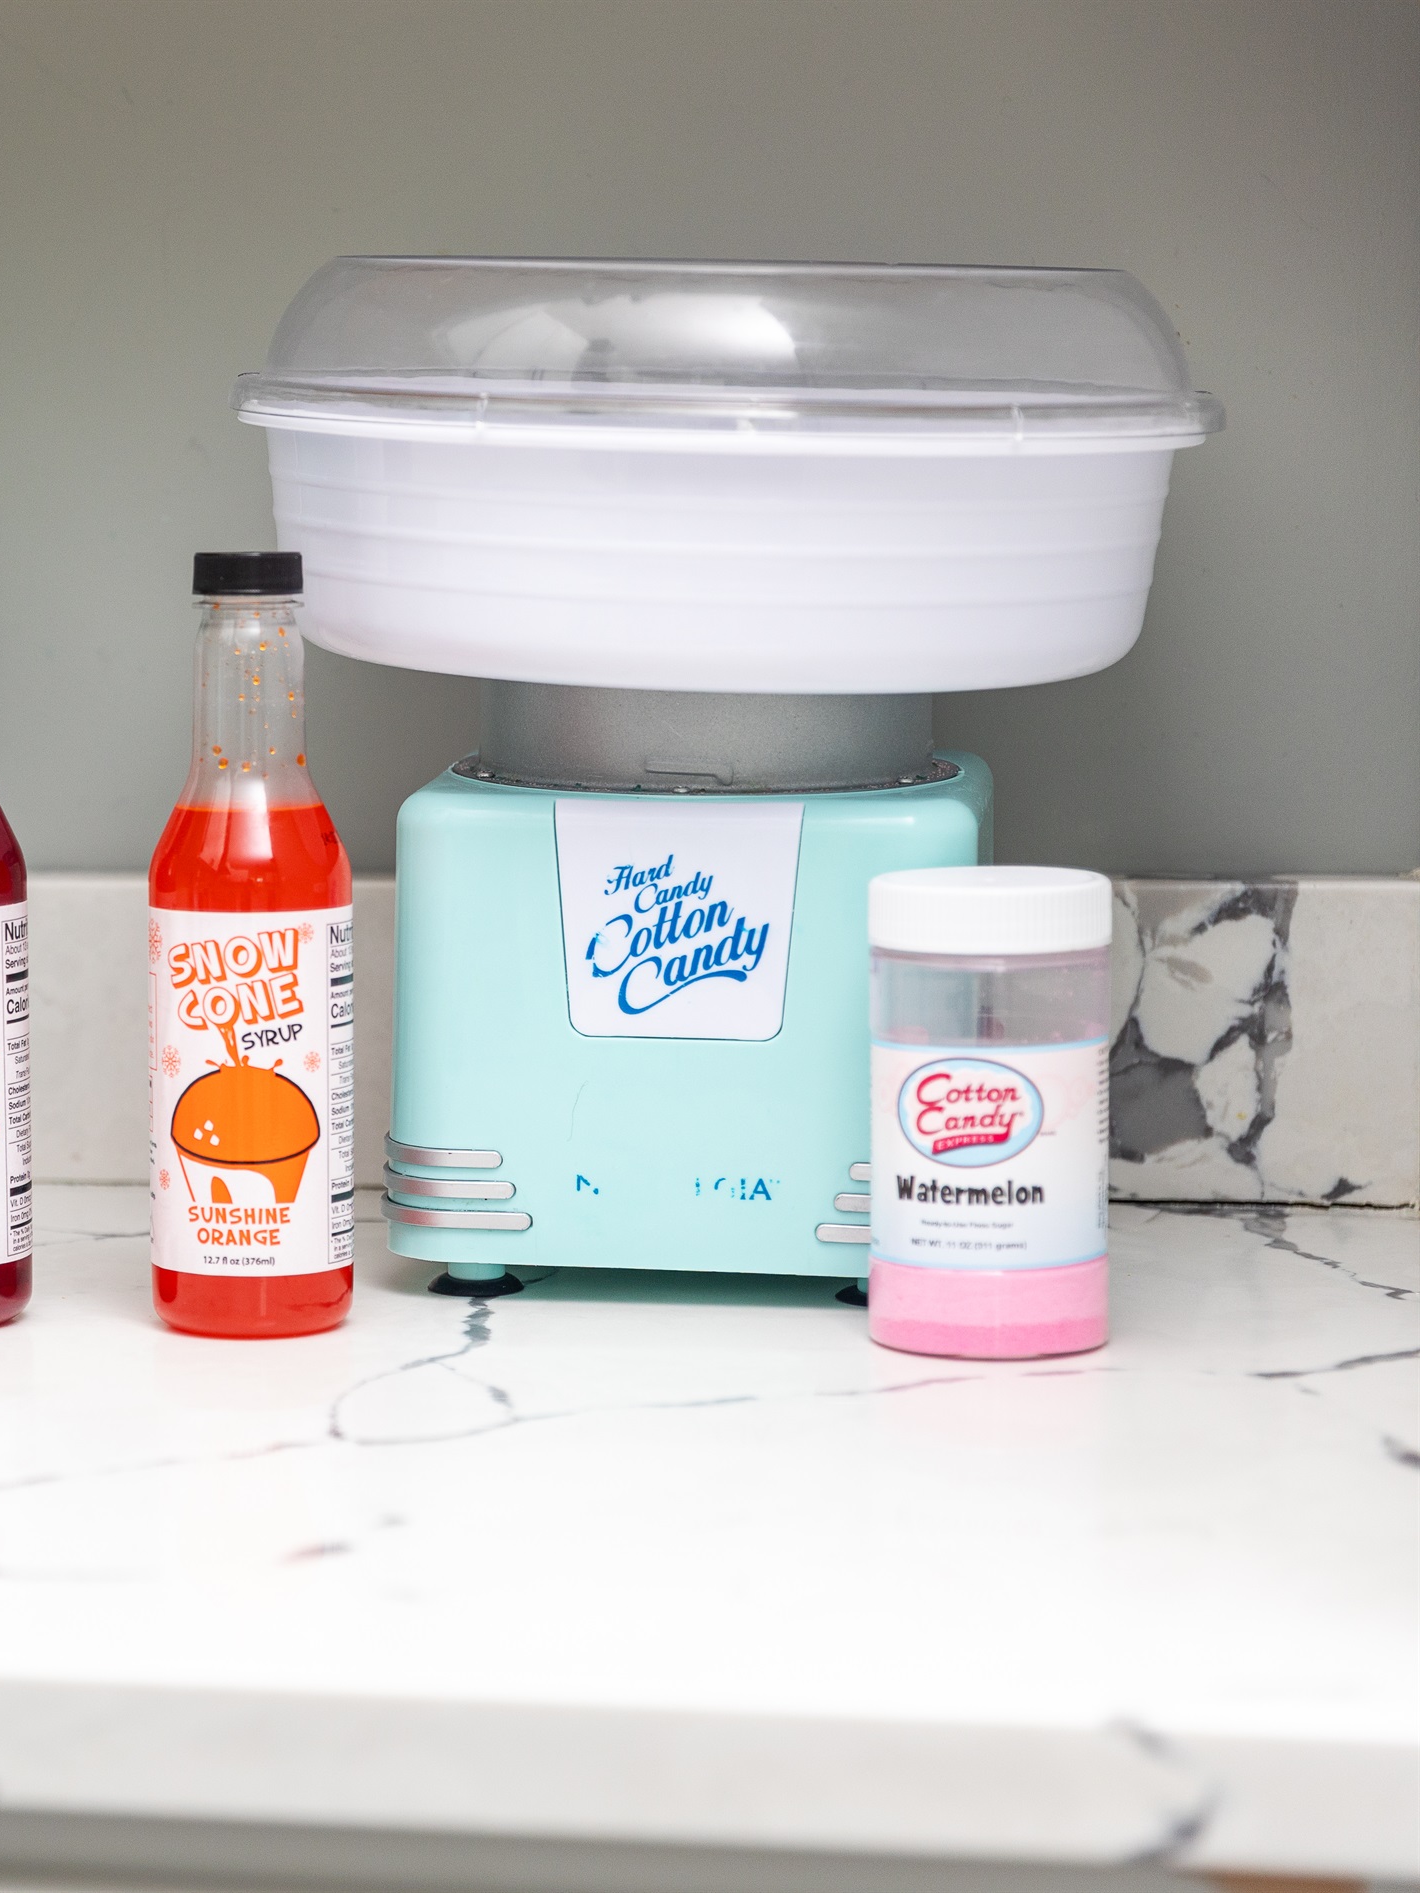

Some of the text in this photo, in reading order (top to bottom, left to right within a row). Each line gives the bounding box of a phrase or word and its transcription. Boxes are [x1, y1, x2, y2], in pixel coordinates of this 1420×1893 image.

[604, 853, 675, 896] Hard
[633, 871, 714, 914] Candy
[585, 900, 735, 979] Cotton
[167, 927, 300, 988] SNOW
[618, 916, 770, 1015] Candy
[178, 971, 304, 1030] CONE
[241, 1023, 303, 1050] SYRUP
[916, 1073, 1022, 1105] Cotton
[916, 1103, 1020, 1138] Candy
[936, 1134, 995, 1151] EXPRESS
[896, 1175, 1045, 1206] Watermelon
[188, 1205, 291, 1225] SUNSHINE
[197, 1228, 281, 1247] ORANGE
[911, 1237, 927, 1247] NET
[995, 1240, 1028, 1252] grams)
[203, 1255, 220, 1265] 12.7
[229, 1257, 240, 1266] oz
[241, 1256, 276, 1267] (376ml)
